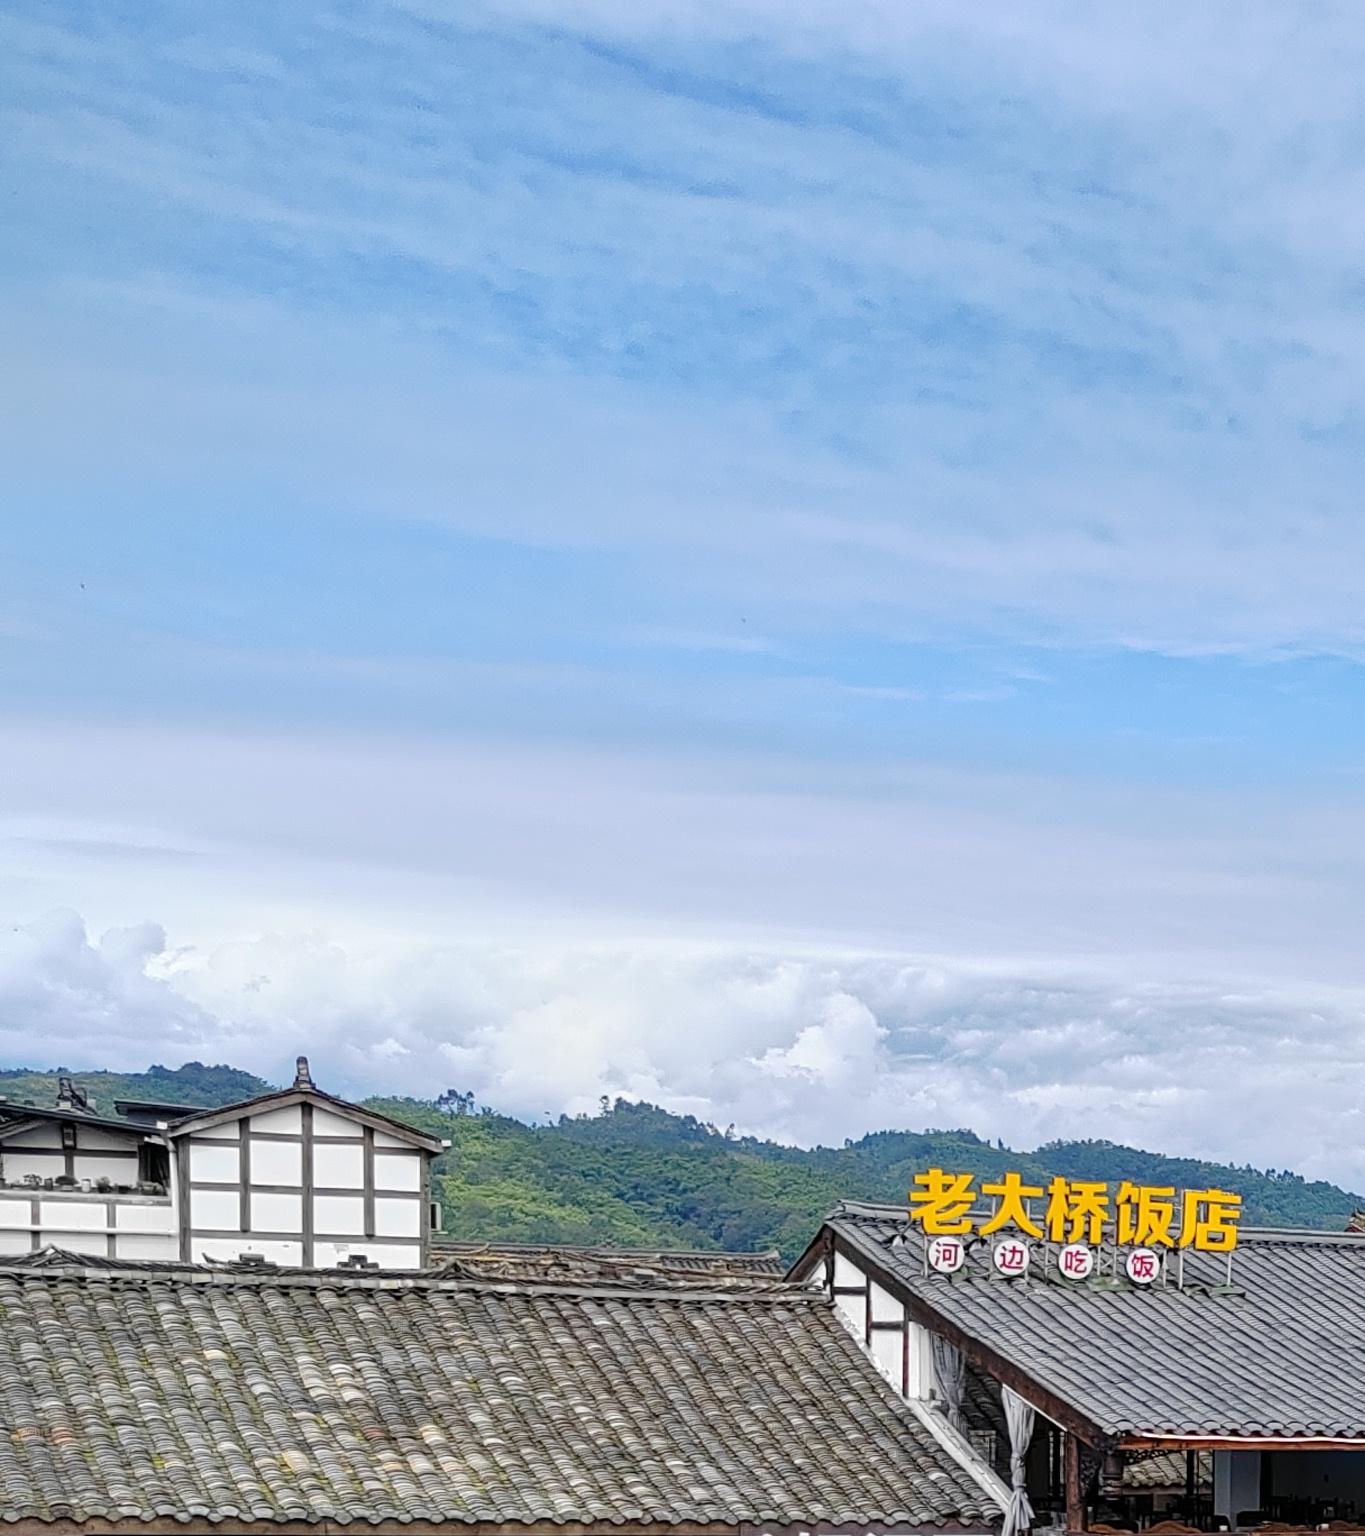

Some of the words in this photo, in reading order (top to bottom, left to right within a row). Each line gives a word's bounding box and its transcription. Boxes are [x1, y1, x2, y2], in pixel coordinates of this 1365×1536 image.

[909, 1168, 1242, 1252] 老大桥饭店
[933, 1241, 1155, 1279] 河边吃饭
